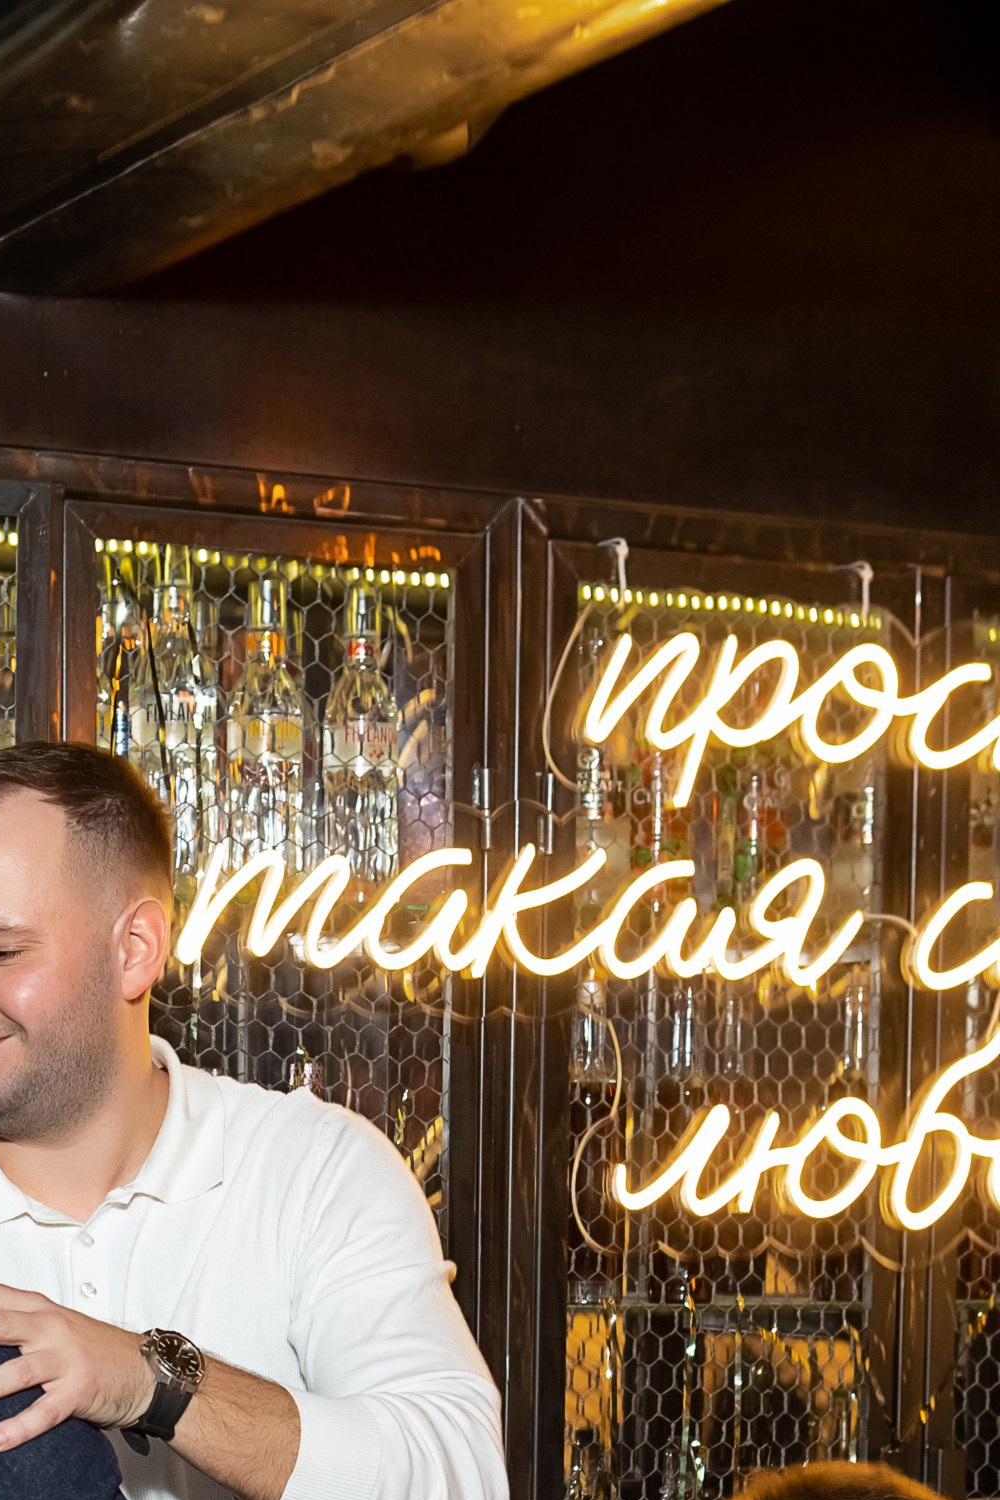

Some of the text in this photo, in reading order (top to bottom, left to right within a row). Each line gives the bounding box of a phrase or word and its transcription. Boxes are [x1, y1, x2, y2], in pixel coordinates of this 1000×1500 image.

[585, 632, 999, 808] прос
[176, 842, 864, 990] такая
[614, 1029, 999, 1231] люб
